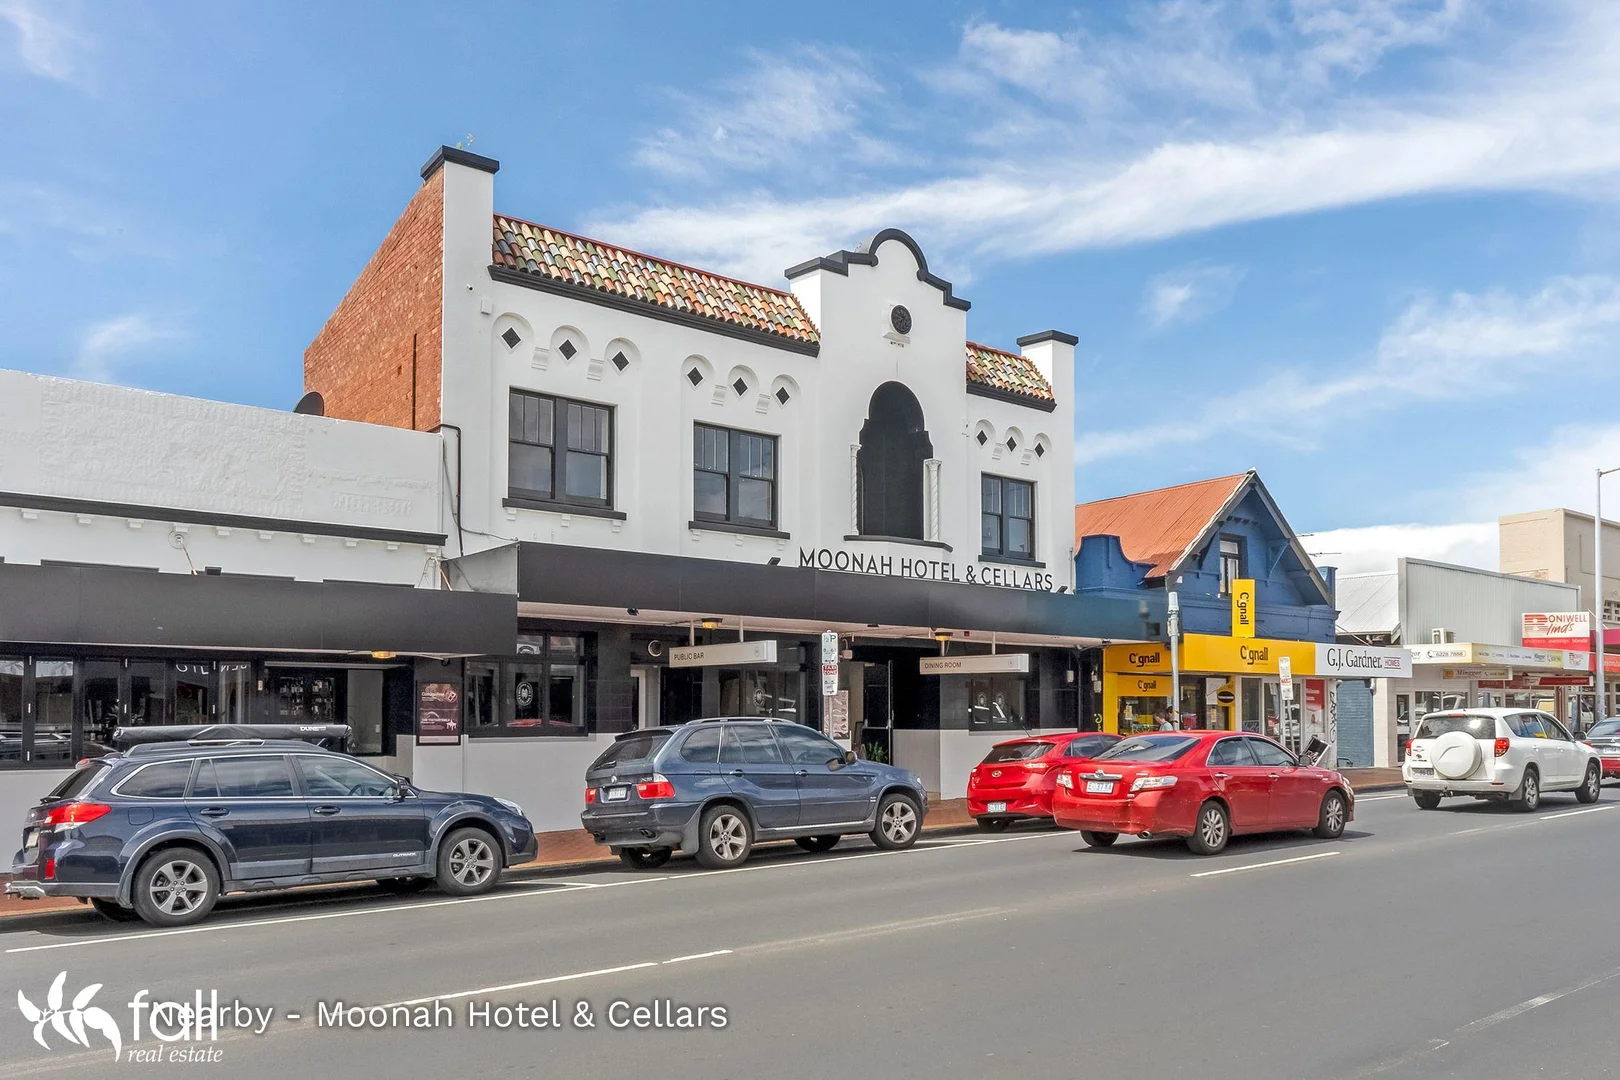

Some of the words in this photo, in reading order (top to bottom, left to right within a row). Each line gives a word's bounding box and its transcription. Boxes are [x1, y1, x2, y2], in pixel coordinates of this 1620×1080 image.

[799, 546, 892, 576] MOONAH
[901, 557, 960, 582] HOTEL
[965, 565, 977, 584] &
[981, 567, 1053, 591] CELLARS
[1236, 591, 1249, 625] Cignall
[673, 653, 692, 661] PUBLIC
[693, 652, 705, 660] BAR
[1129, 652, 1160, 667] Cignall
[1240, 645, 1269, 665] Cignall
[1327, 647, 1344, 671] G.J.
[1345, 649, 1383, 668] Gardner.
[924, 661, 944, 669] DINING
[944, 661, 962, 669] ROOM
[1138, 679, 1157, 692] Cignall
